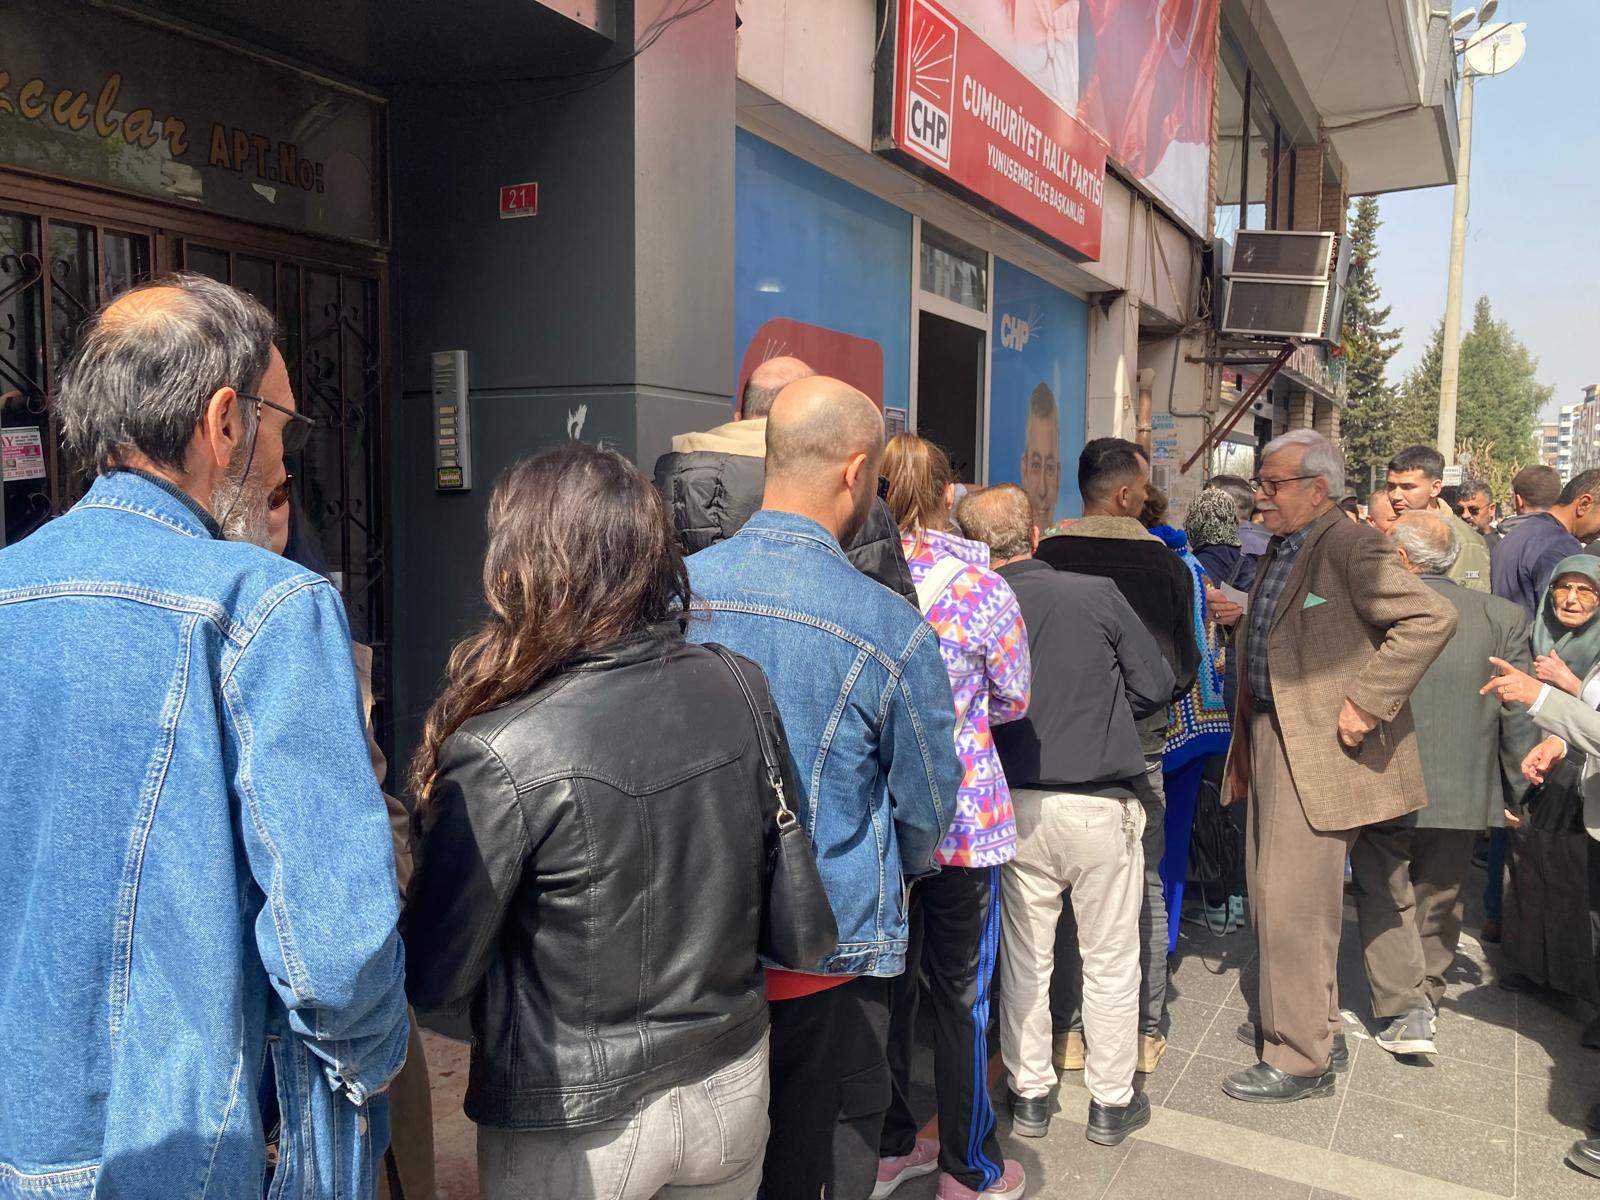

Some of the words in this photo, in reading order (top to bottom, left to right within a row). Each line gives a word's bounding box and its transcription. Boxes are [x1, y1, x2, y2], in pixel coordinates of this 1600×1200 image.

[910, 99, 948, 150] CHP
[962, 74, 1042, 161] CUMHURİYET
[1042, 135, 1070, 184] HALK
[1069, 157, 1104, 209] PARTİSİ
[509, 189, 525, 209] 21
[987, 142, 1034, 193] YUNUSEMRE
[1033, 170, 1050, 203] İLÇE
[1049, 186, 1085, 226] BAŞKANLIĞI
[1001, 313, 1030, 352] CHP
